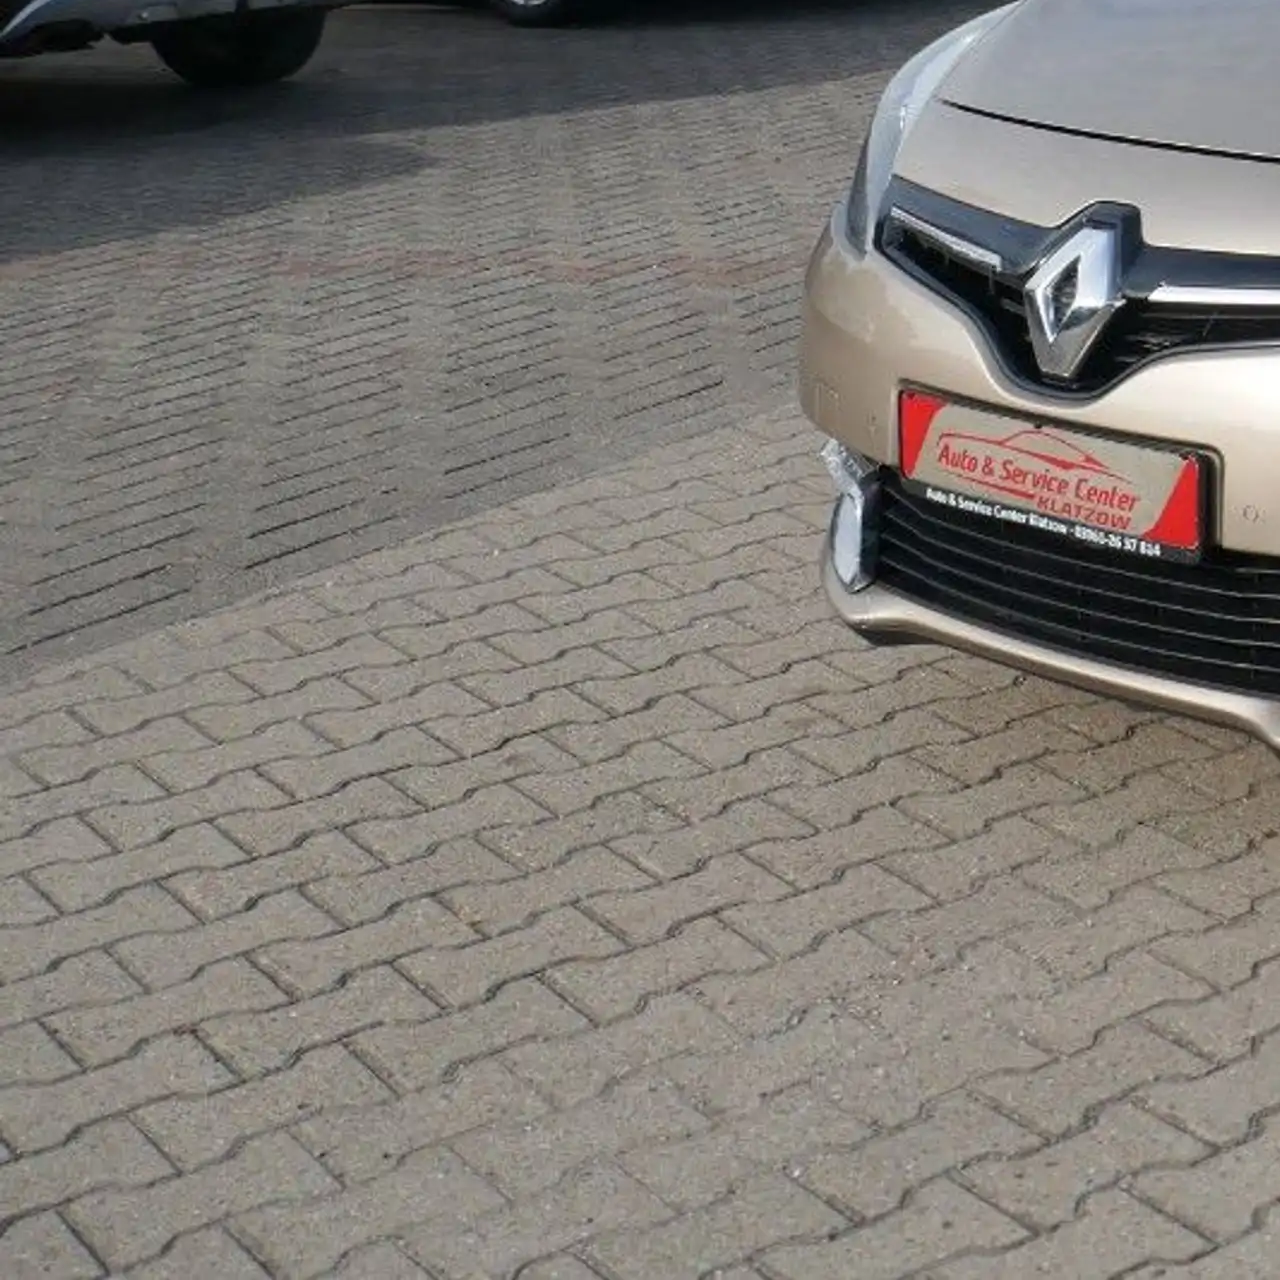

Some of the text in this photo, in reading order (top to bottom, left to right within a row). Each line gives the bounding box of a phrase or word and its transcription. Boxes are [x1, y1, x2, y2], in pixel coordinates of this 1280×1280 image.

[938, 444, 1139, 512] Auto & Service Center
[1036, 495, 1132, 530] KLATZOW
